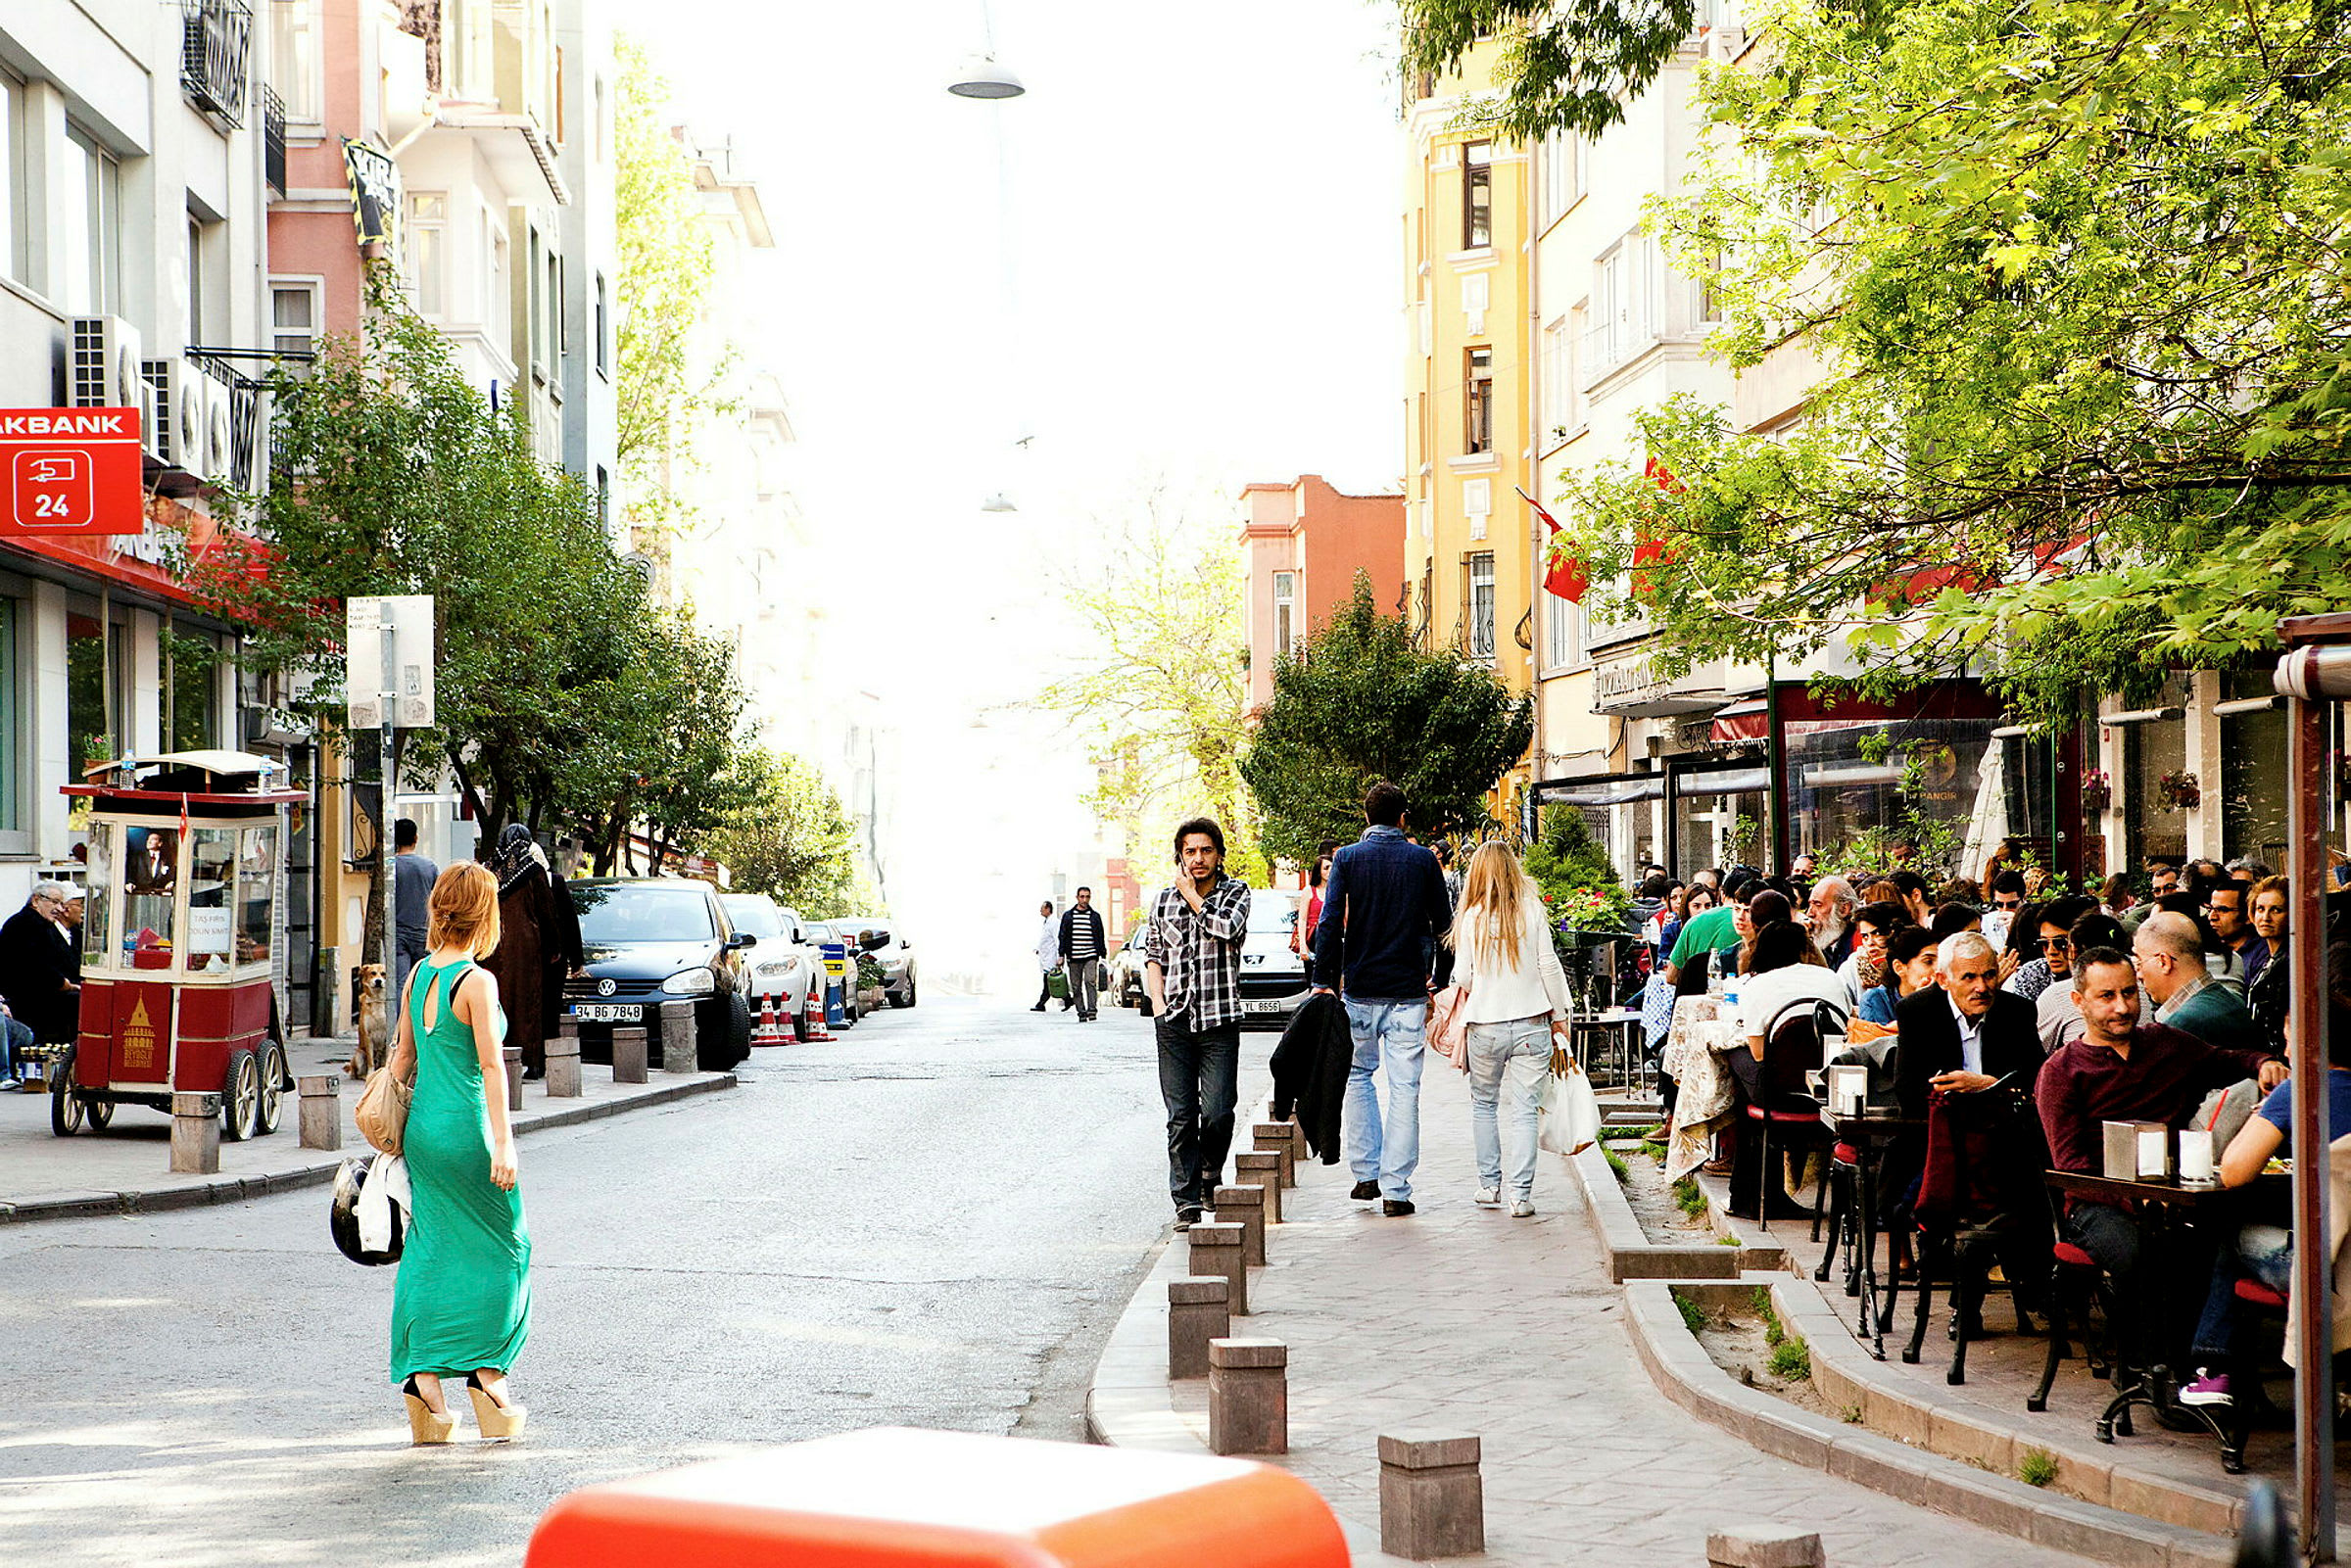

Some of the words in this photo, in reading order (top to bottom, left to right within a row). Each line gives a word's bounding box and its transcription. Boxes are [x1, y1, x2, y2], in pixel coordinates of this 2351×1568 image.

[35, 494, 69, 517] 24
[577, 1006, 590, 1018] 34
[595, 1006, 607, 1018] BG
[613, 1006, 641, 1018] 7848
